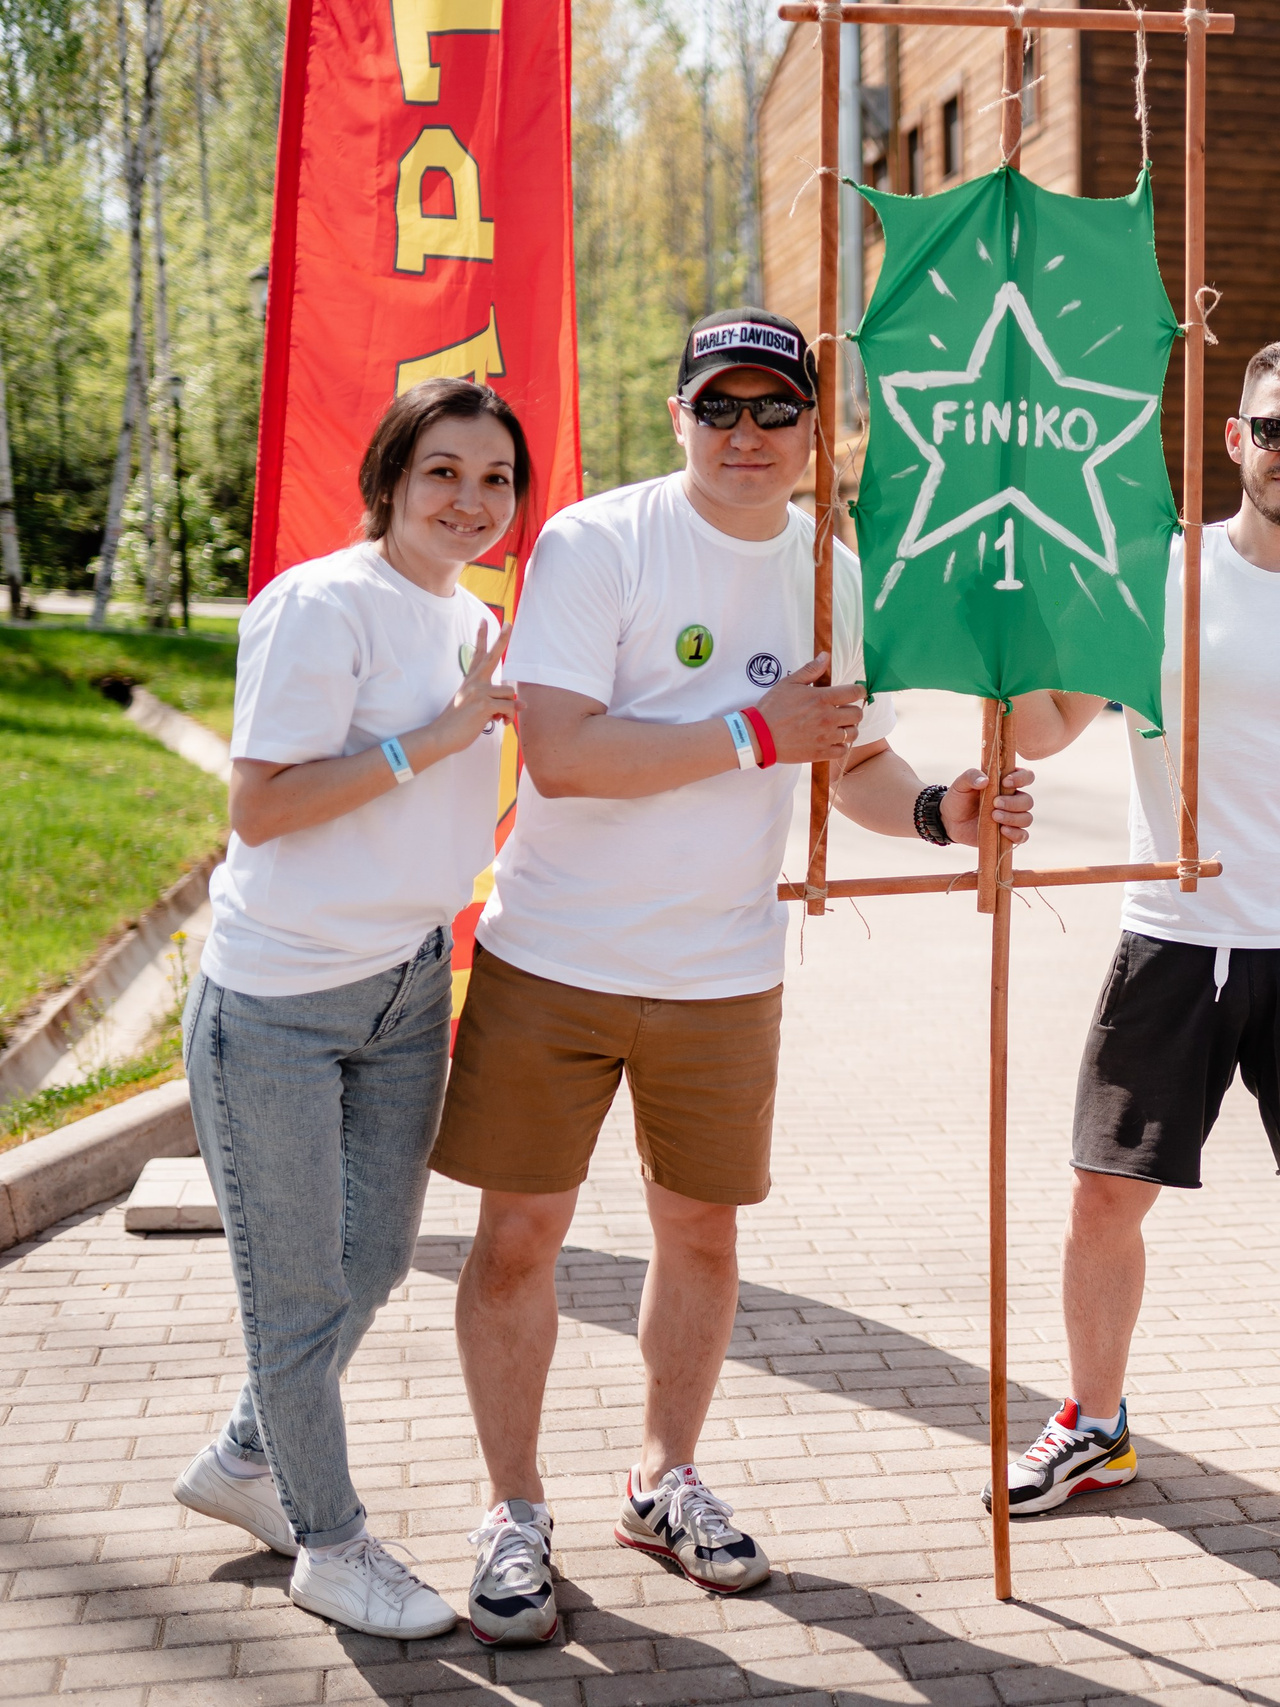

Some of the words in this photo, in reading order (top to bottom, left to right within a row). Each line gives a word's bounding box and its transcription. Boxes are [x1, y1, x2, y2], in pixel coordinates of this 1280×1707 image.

[695, 326, 796, 356] HARLEY-DAVIDSON
[993, 517, 1025, 591] 1
[688, 632, 705, 660] 1
